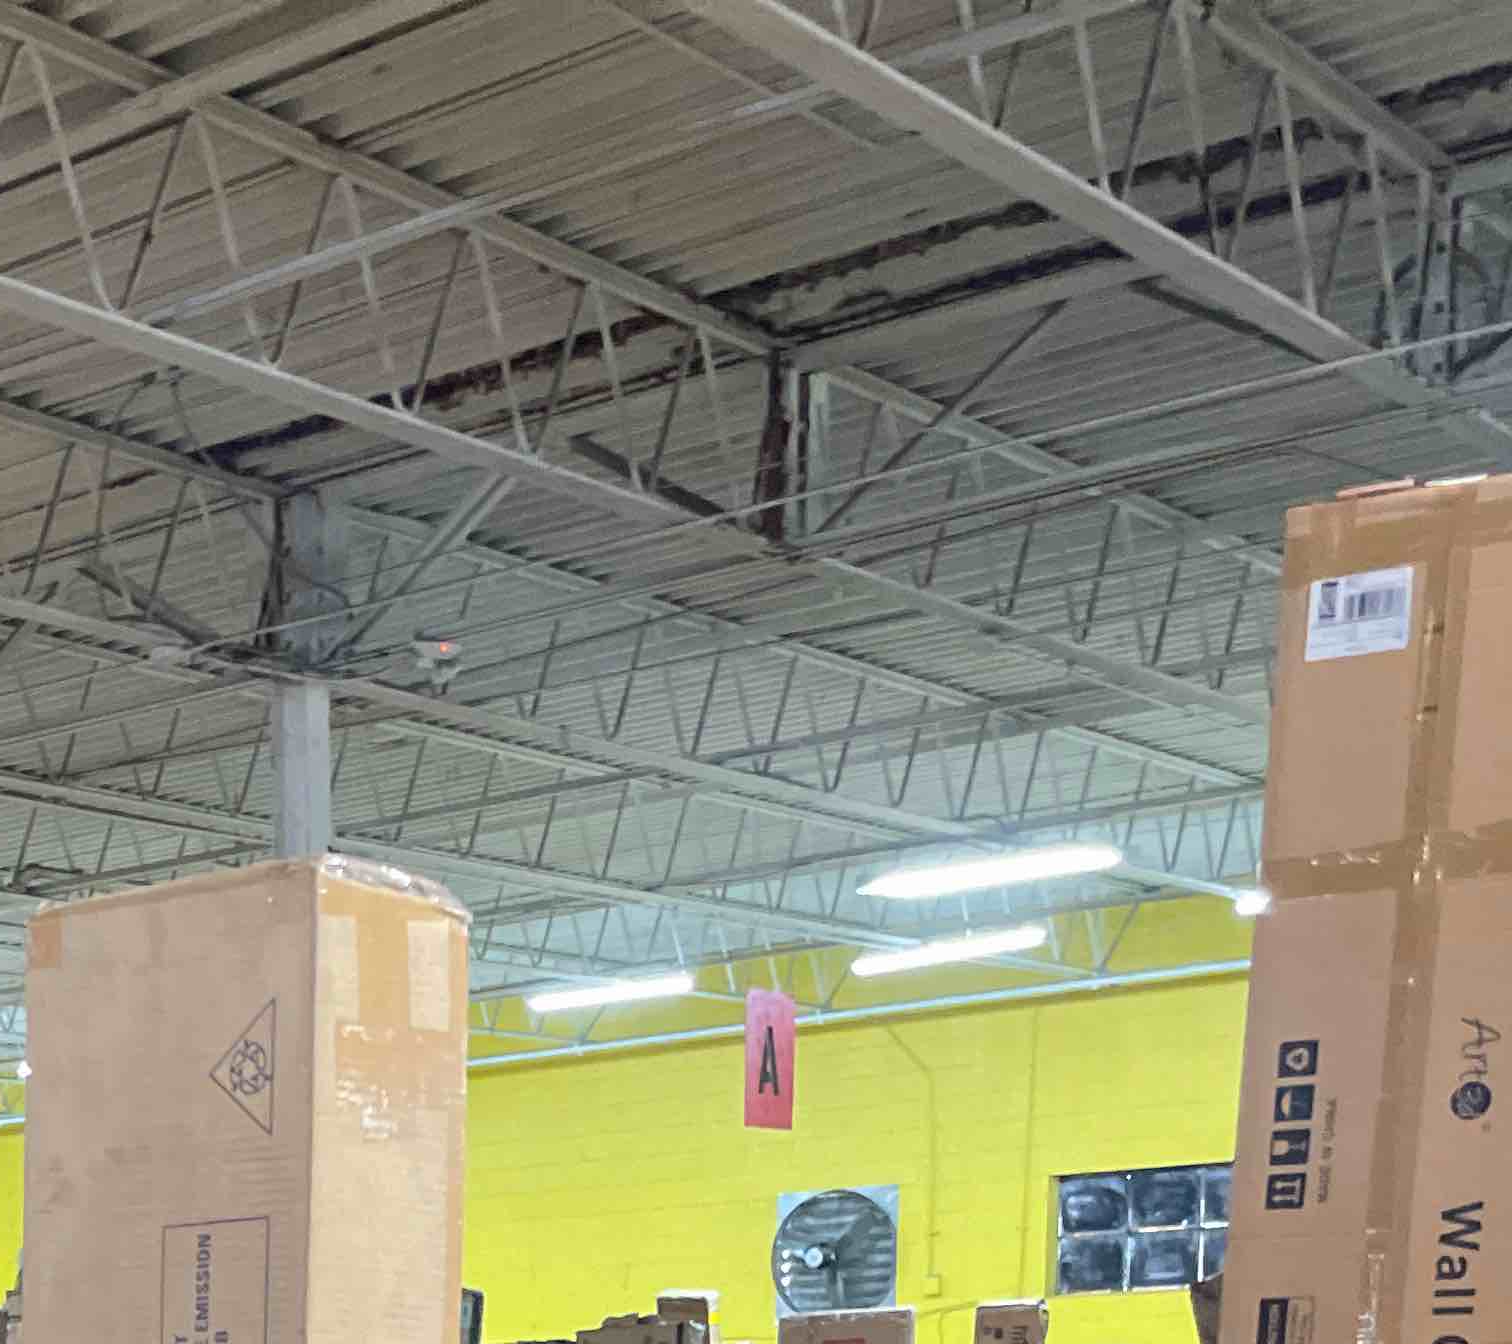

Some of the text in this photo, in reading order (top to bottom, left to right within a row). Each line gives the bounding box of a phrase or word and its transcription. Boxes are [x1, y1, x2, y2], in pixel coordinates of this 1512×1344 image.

[757, 1025, 780, 1096] A
[194, 1233, 212, 1333] EMISSION
[1432, 1200, 1484, 1316] Wall
